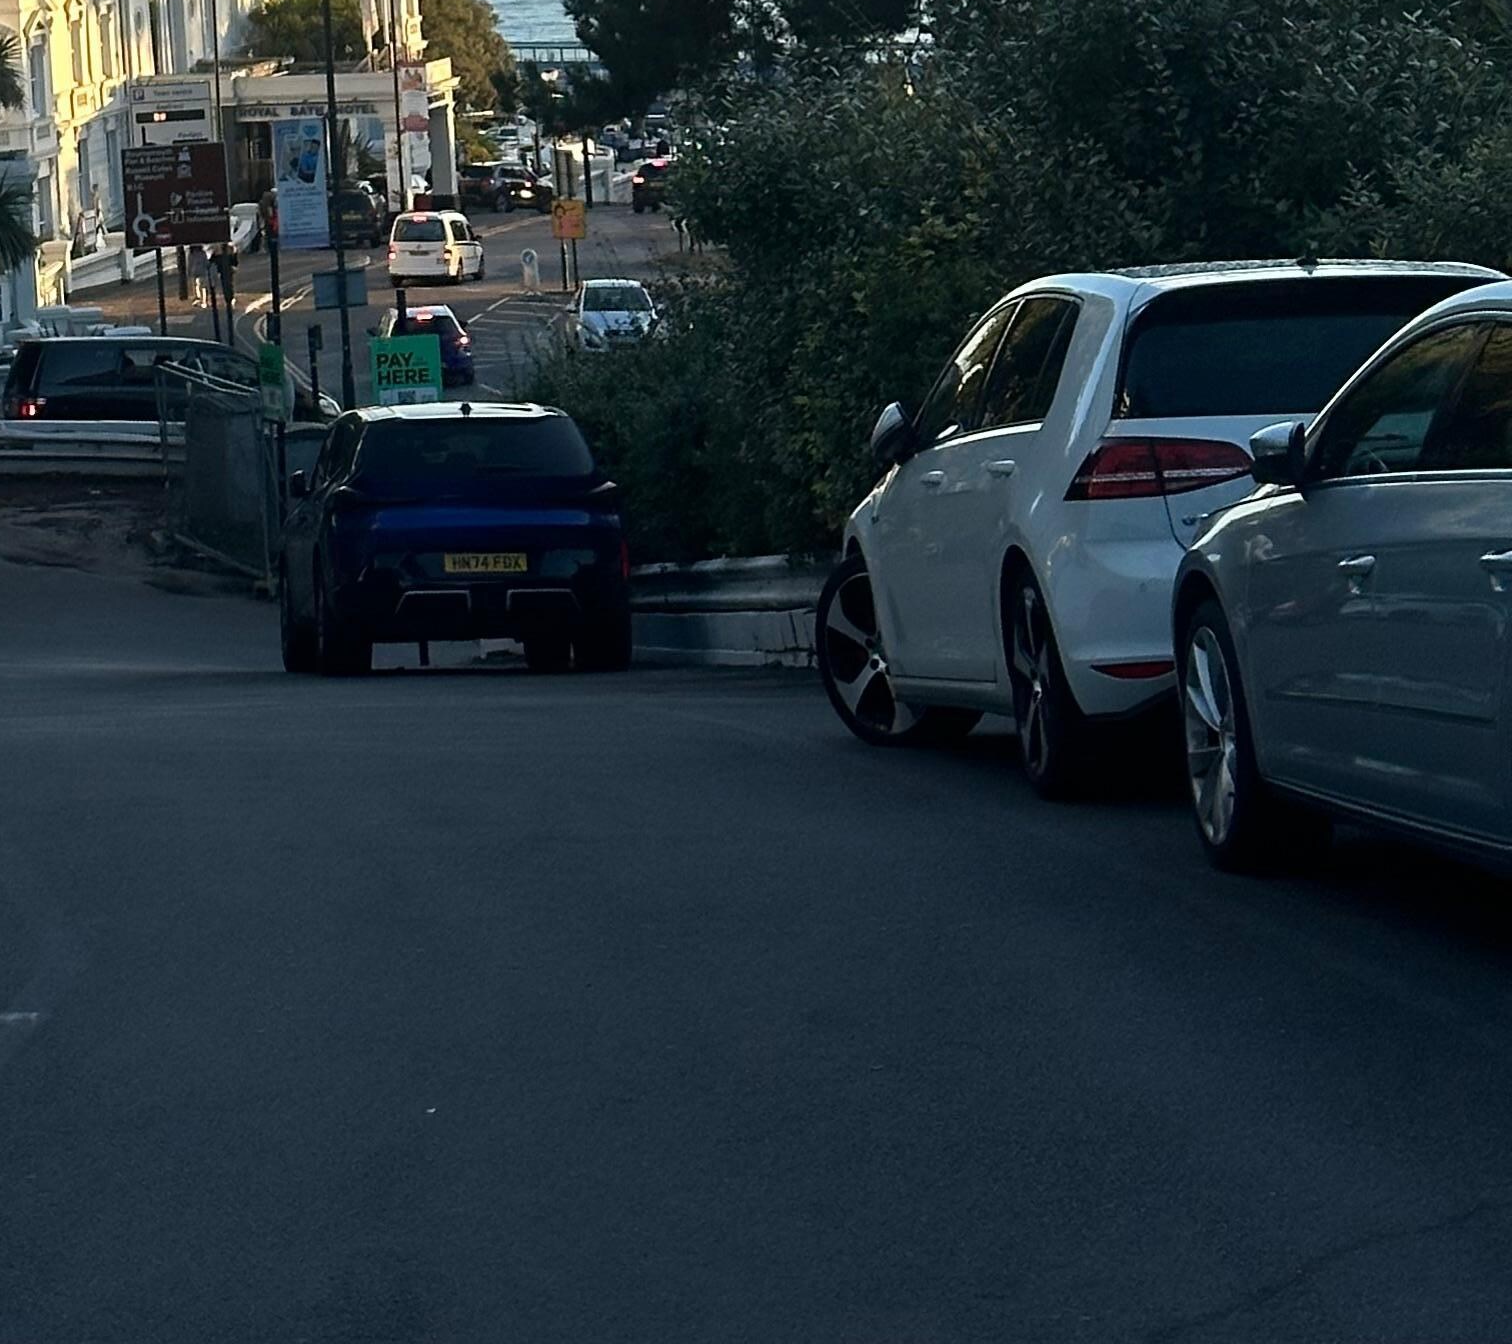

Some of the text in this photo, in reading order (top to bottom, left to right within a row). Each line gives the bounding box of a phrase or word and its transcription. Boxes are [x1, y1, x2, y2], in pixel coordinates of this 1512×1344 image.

[239, 102, 378, 118] ROYAL BATH HOTEL
[376, 352, 414, 369] PAY
